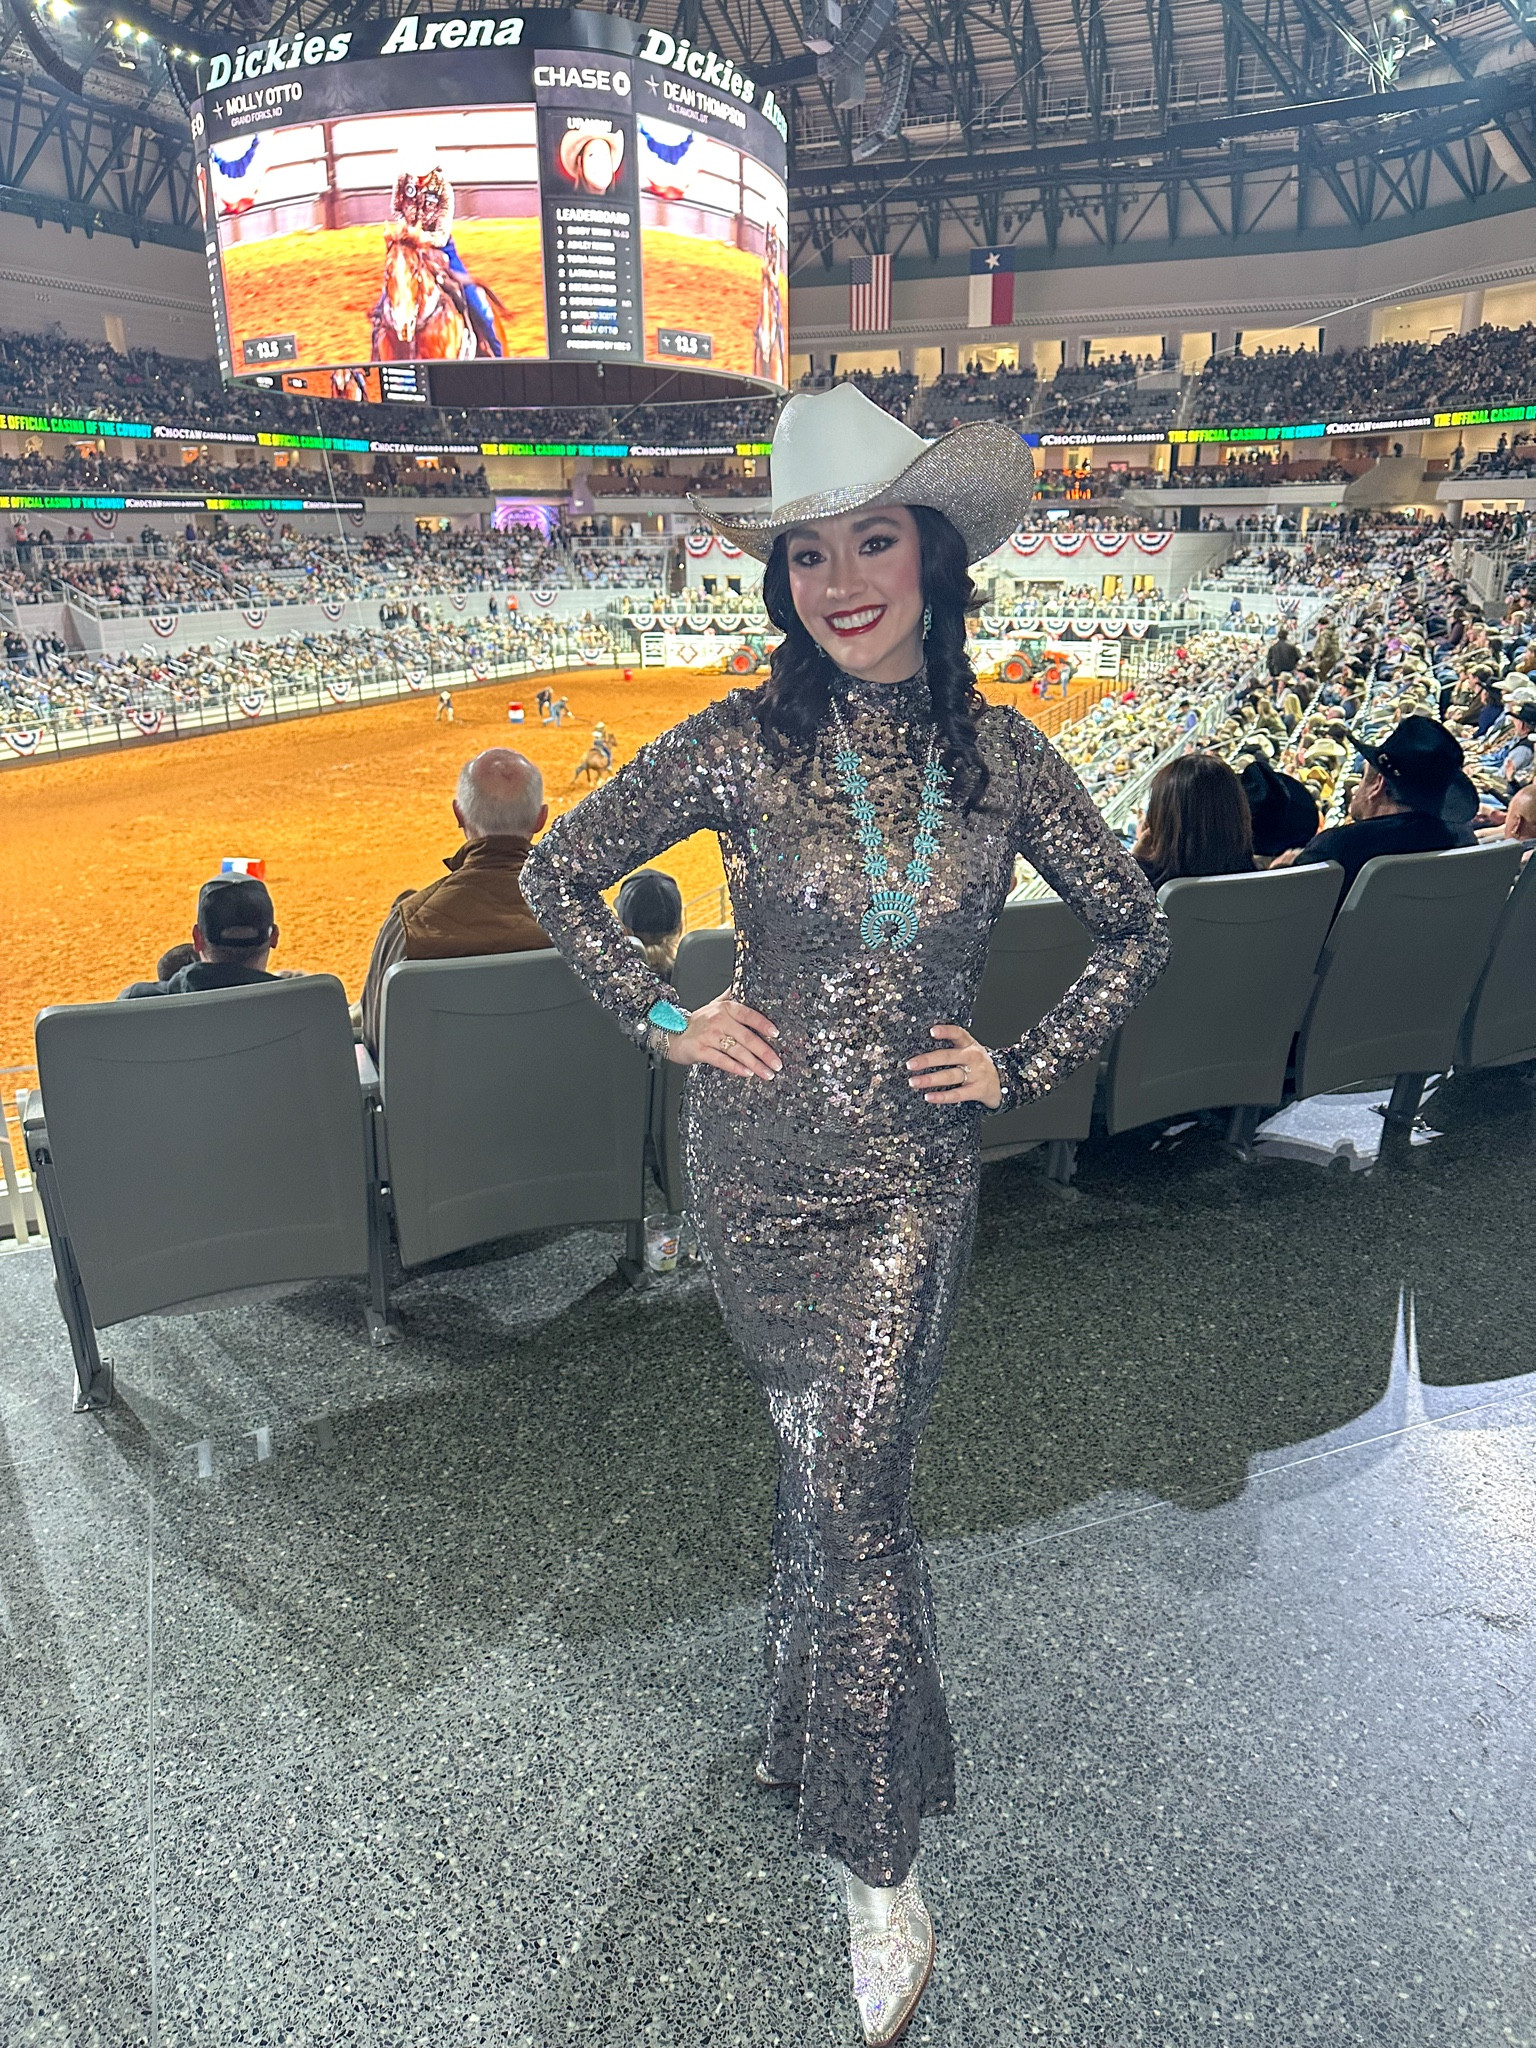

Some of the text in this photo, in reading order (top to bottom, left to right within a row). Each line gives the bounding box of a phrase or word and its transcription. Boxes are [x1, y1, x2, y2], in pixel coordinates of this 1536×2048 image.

[206, 15, 525, 91] Dickies Arena
[639, 28, 756, 104] Dickies
[534, 66, 611, 91] CHASE
[225, 82, 303, 117] MOLLY OTTO
[663, 80, 747, 130] DEAN THOMPSON
[556, 208, 630, 226] LEADERBOARD
[1433, 413, 1451, 428] THE
[1451, 410, 1489, 426] OFFICIAL
[1490, 406, 1525, 422] CASINO
[8, 415, 51, 431] OFFICIAL
[51, 418, 84, 434] CASINO
[86, 420, 98, 434] OF
[98, 421, 116, 436] THE
[116, 422, 152, 438] COWBOY
[157, 425, 202, 440] CHOCTAW
[1168, 429, 1187, 443] THE
[1187, 428, 1229, 442] OFFICIAL
[1229, 427, 1266, 441] CASINO
[1267, 427, 1280, 440] OF
[1329, 421, 1372, 435] CHOCTAW
[372, 441, 414, 453] CHOCTAW
[1046, 434, 1096, 446] CHOCTAW
[480, 443, 498, 456] THE
[498, 443, 535, 456] OFFICIAL
[634, 445, 678, 456] CHOCTAW
[736, 443, 751, 456] THE
